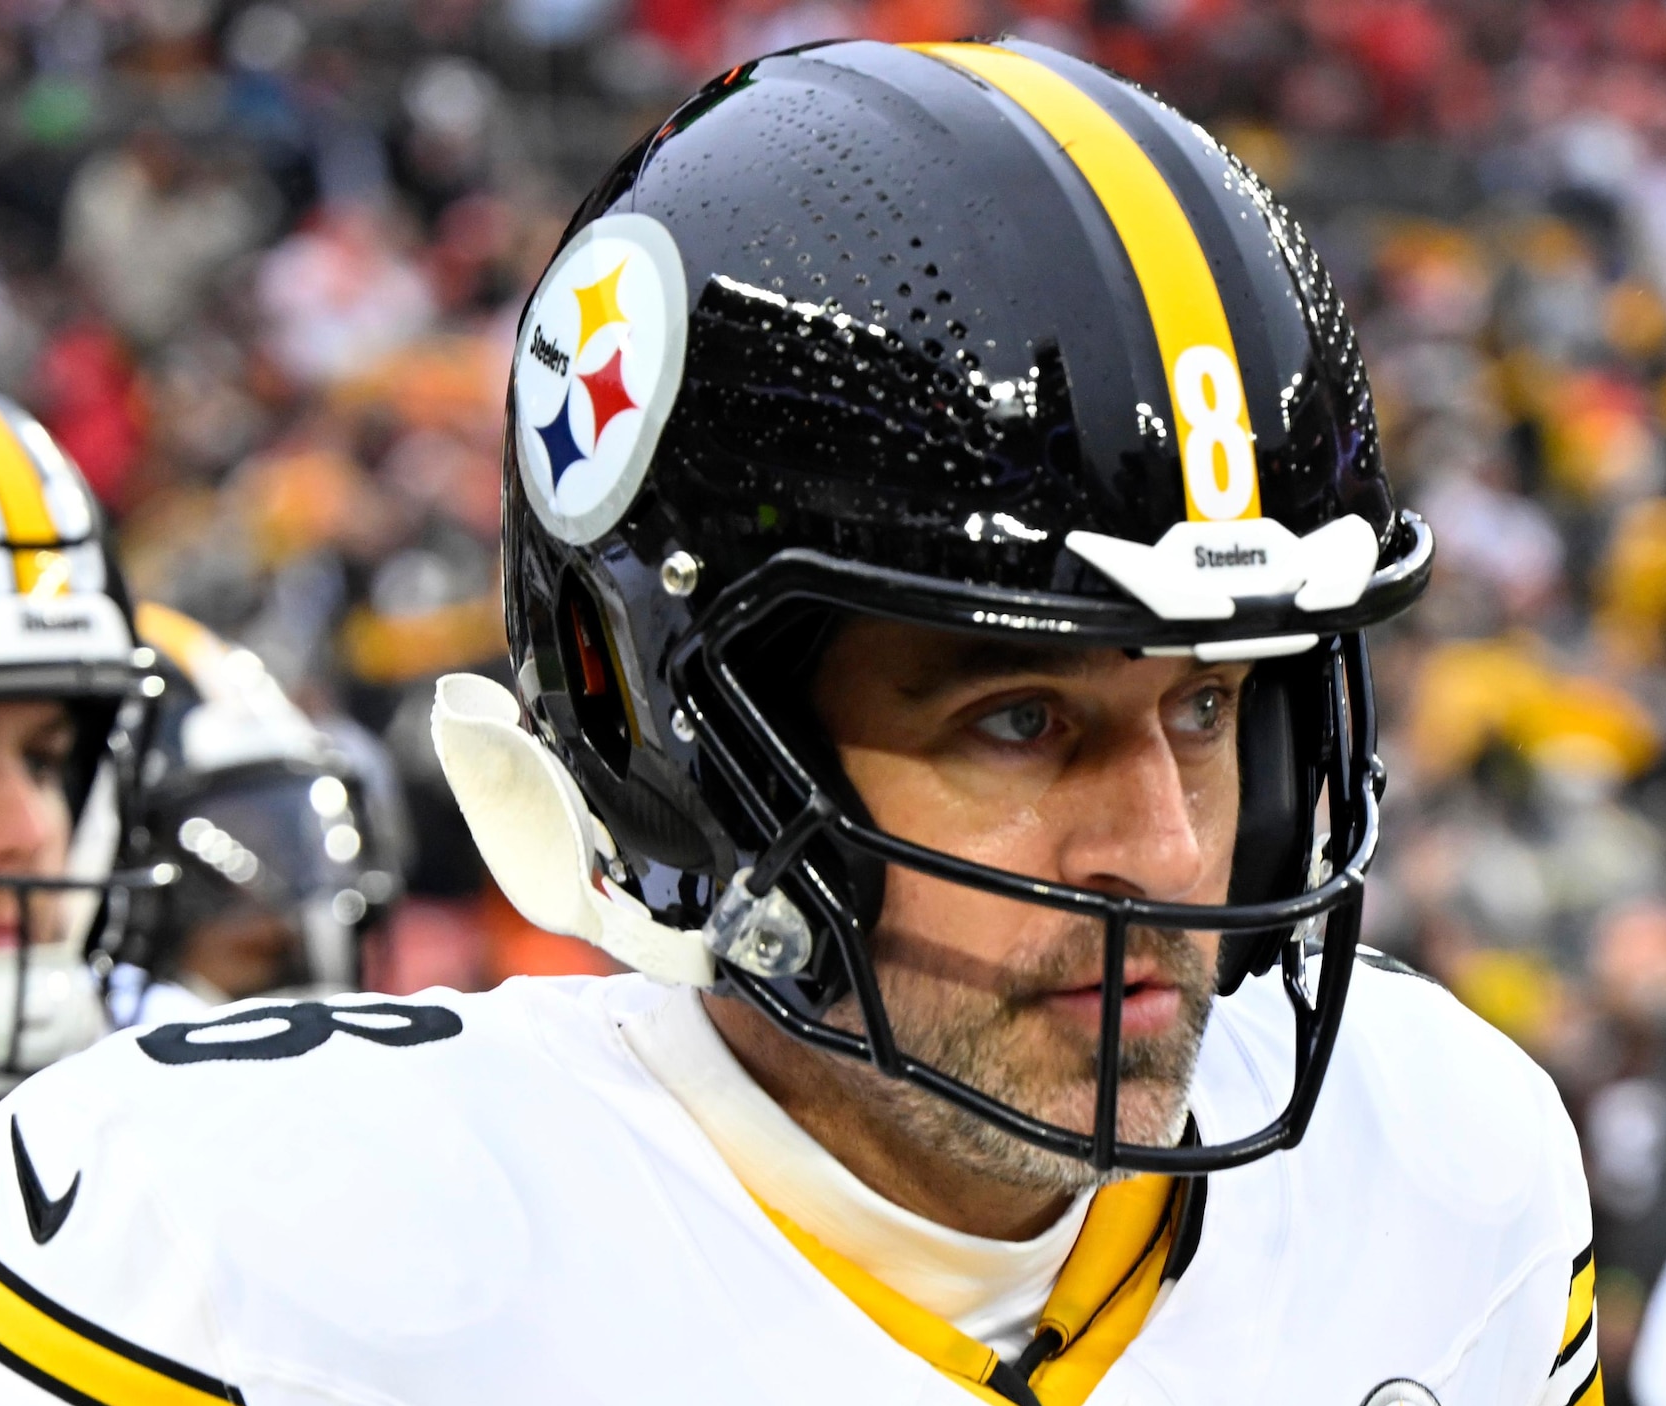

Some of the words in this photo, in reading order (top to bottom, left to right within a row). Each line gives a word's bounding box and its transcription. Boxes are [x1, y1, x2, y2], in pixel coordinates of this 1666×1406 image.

[529, 324, 570, 378] Steelers
[1173, 344, 1255, 521] 8
[1194, 542, 1267, 568] Steelers
[135, 1002, 464, 1065] 8
